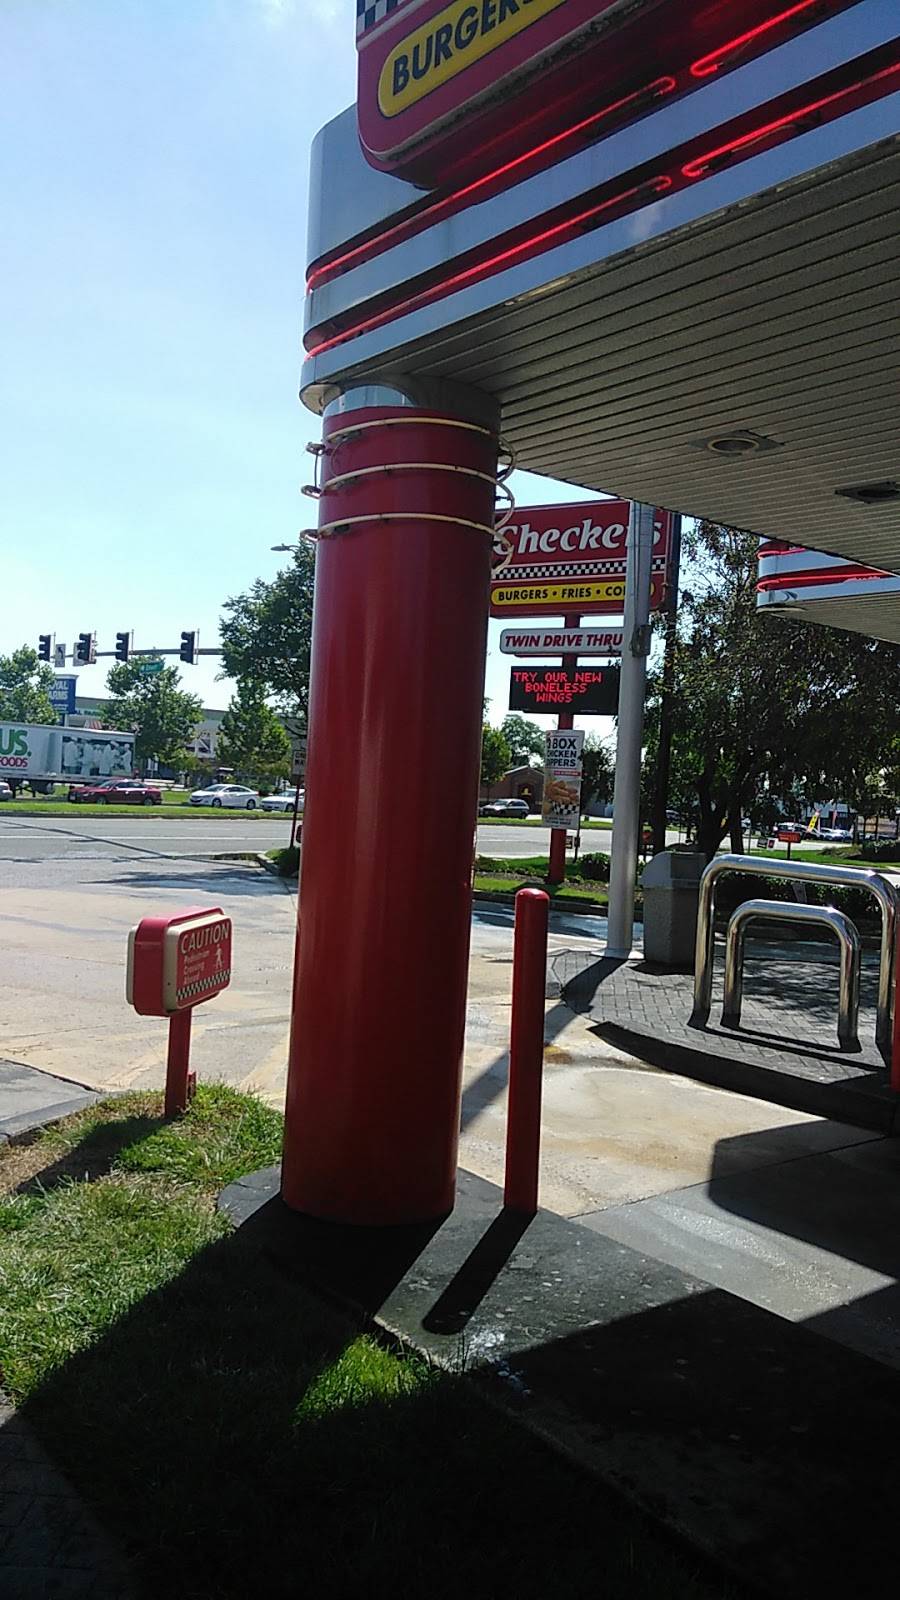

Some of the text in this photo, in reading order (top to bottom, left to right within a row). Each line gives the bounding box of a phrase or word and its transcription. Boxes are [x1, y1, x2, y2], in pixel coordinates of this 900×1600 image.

[393, 0, 532, 96] BURGER
[493, 519, 663, 556] Checkes
[498, 588, 549, 601] BURGERS
[561, 587, 592, 598] FRIES
[505, 633, 624, 647] TWIN DRIVE THRU
[513, 672, 602, 683] TRY OUR NEW
[525, 683, 588, 693] BONELESS
[536, 693, 573, 703] WINGS
[181, 921, 230, 955] CAUTION
